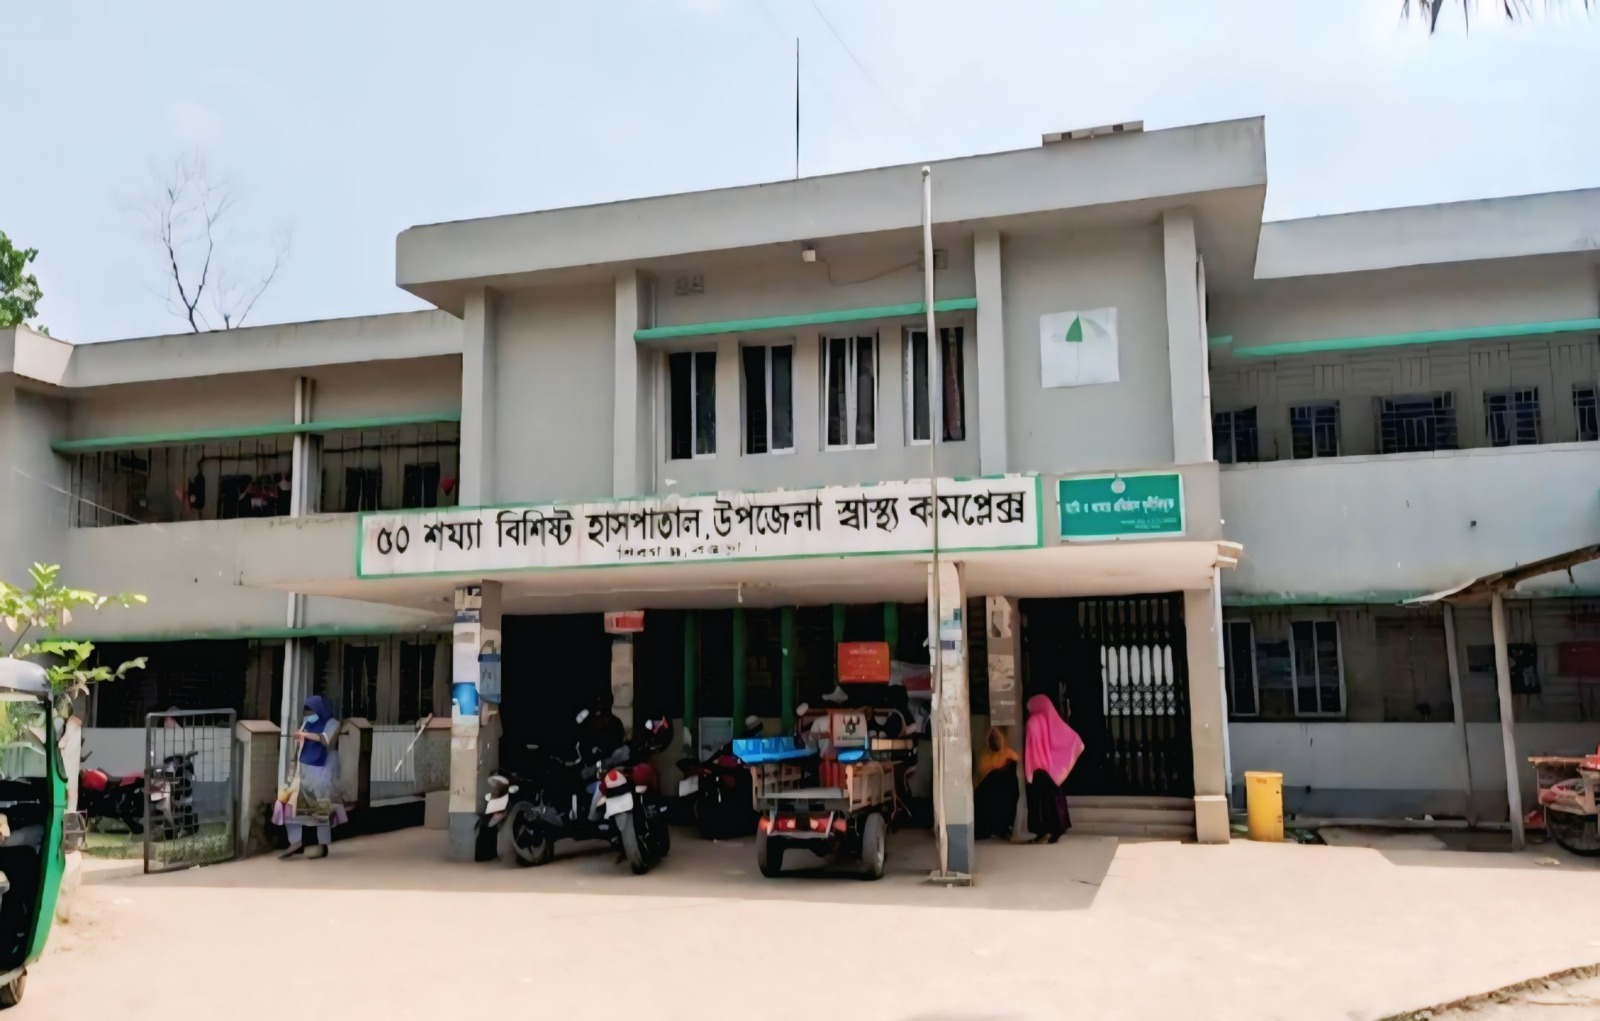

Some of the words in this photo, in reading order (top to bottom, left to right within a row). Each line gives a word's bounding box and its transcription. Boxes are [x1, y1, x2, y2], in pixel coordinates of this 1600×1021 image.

[377, 525, 410, 554] ৫০
[424, 518, 482, 551] শয্যা
[496, 506, 574, 548] বিশিষ্ট
[713, 499, 822, 537] উপজেলা
[835, 493, 898, 533] স্বাস্থ্য
[908, 490, 1026, 527] কমপ্লেক্স
